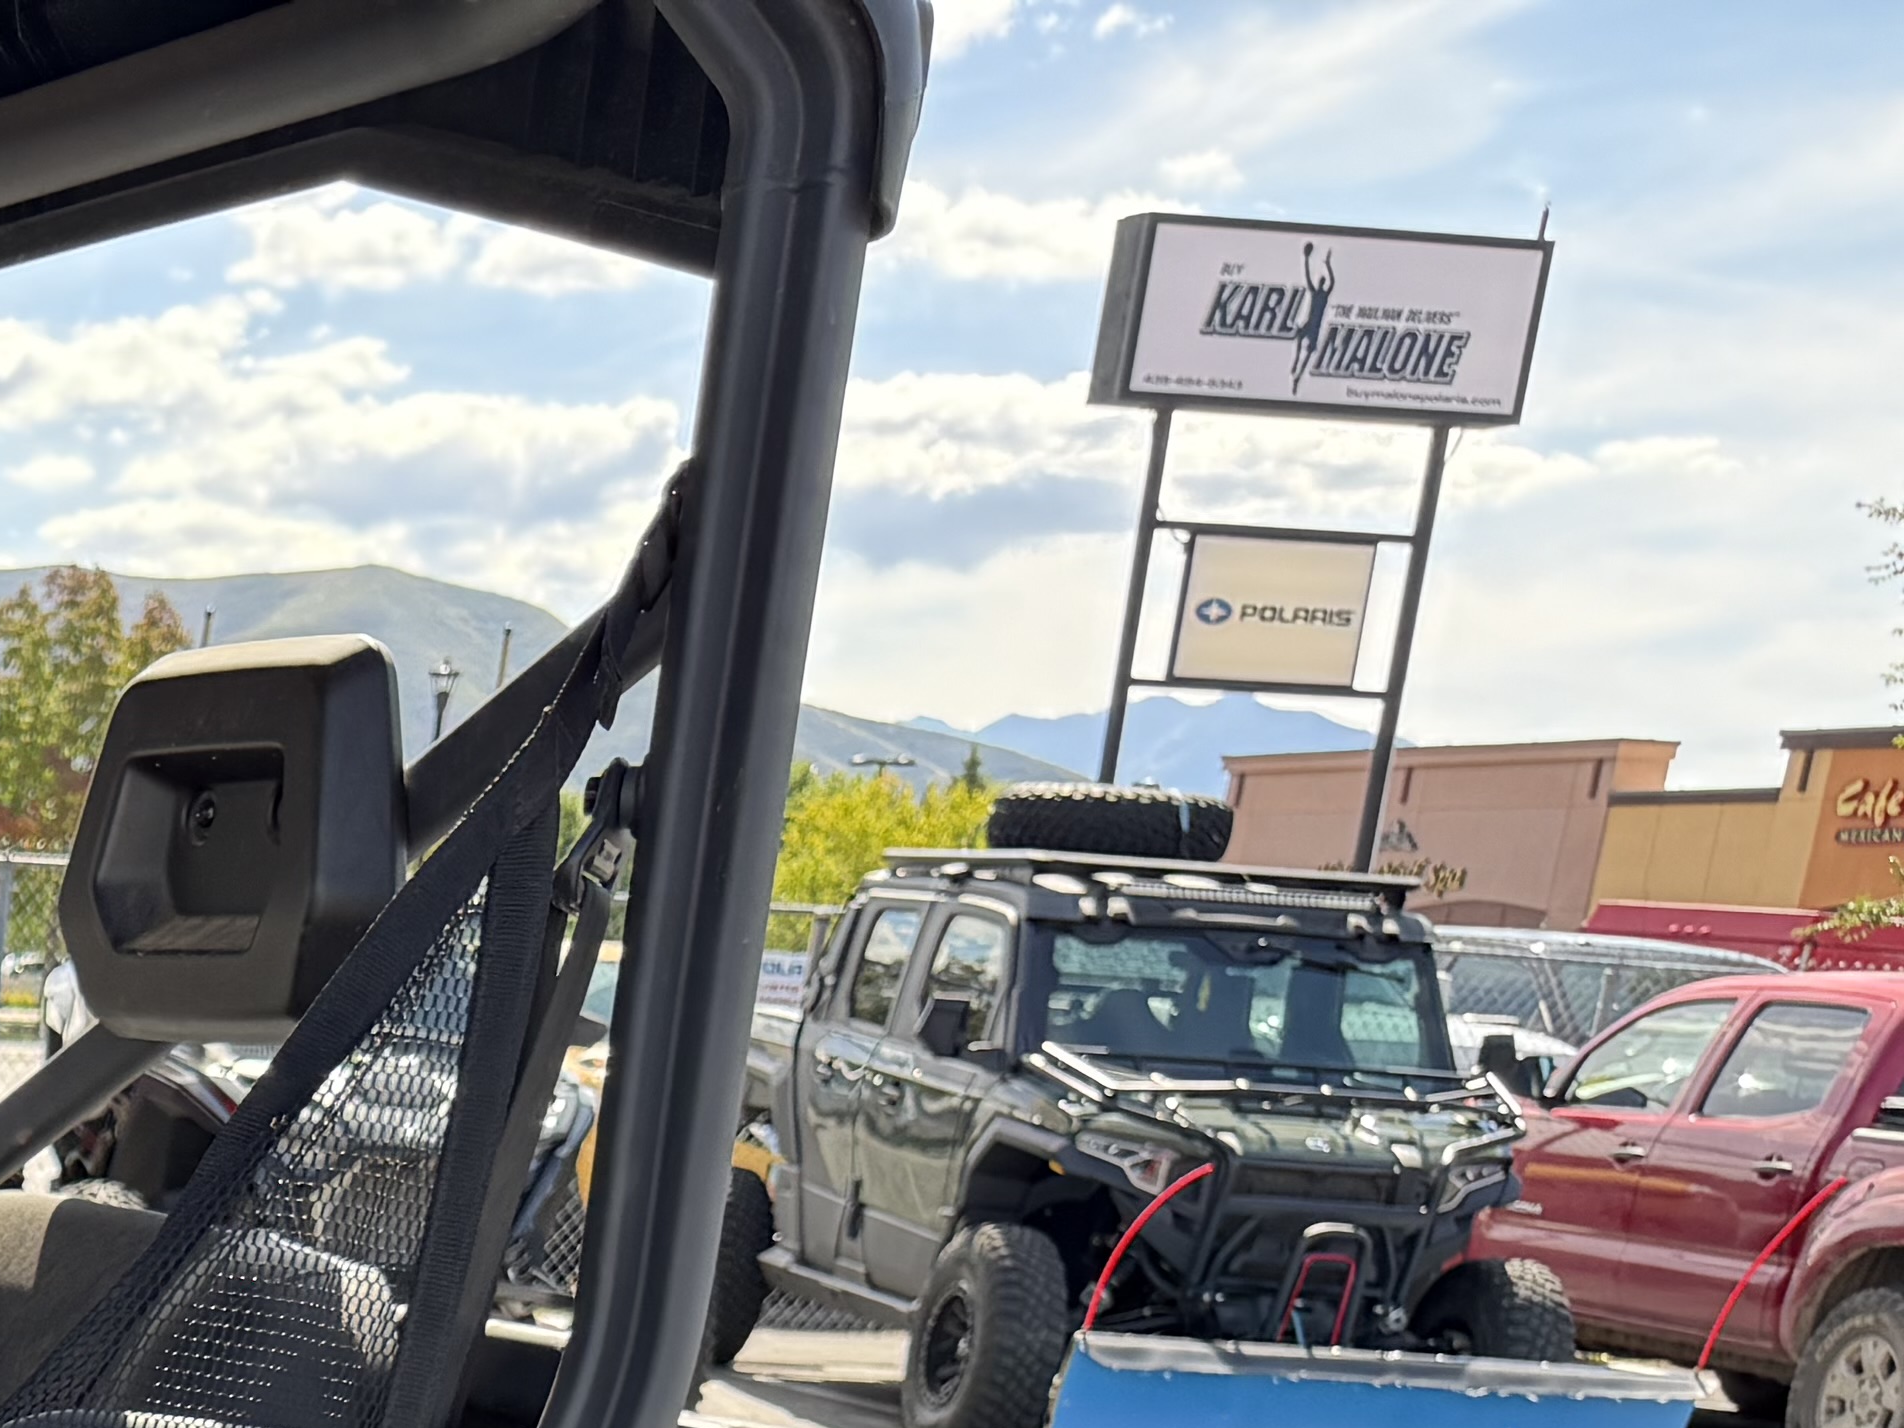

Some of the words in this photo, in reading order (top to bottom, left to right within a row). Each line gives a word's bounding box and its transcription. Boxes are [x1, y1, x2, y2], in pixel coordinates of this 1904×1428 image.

[1200, 279, 1308, 340] KARL
[1311, 322, 1471, 386] MALONE
[1239, 604, 1354, 627] POLARIS
